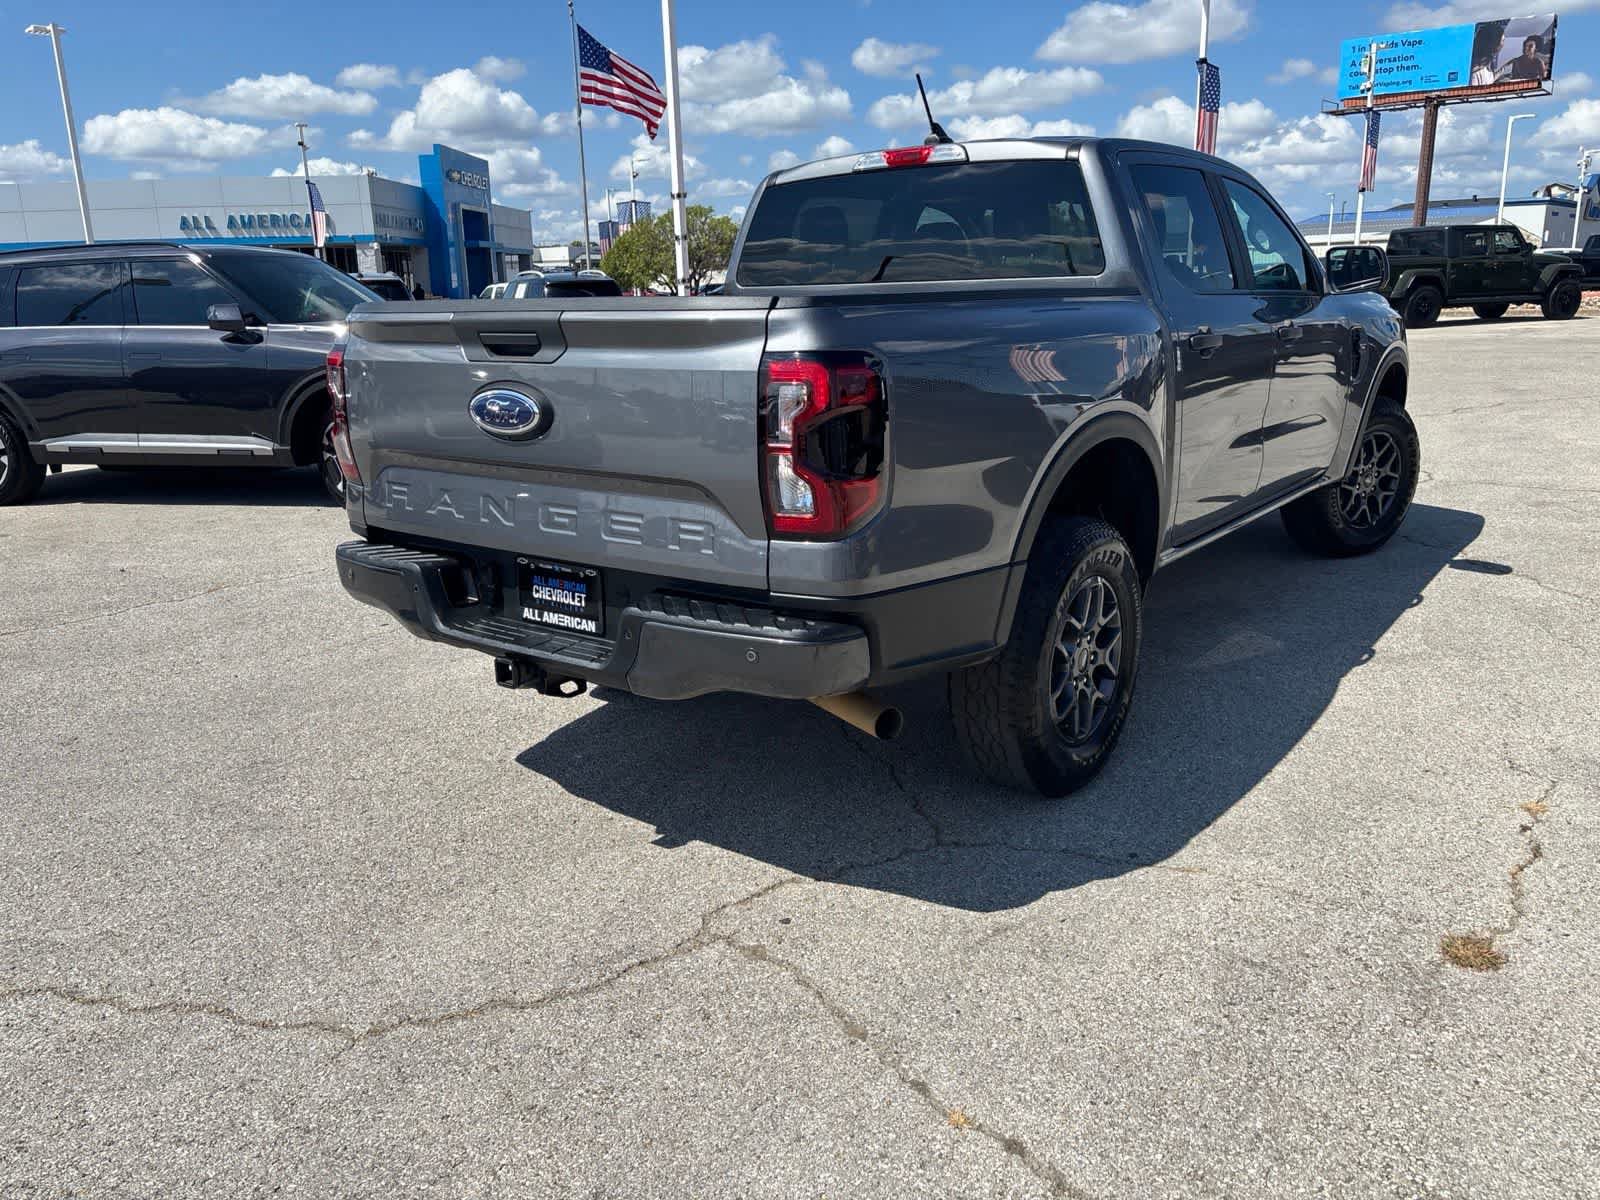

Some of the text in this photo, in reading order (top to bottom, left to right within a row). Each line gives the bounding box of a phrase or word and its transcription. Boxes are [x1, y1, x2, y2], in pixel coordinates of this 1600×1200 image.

[1358, 44, 1366, 52] in
[1401, 38, 1424, 48] Vape.
[1396, 63, 1422, 73] them.
[180, 212, 328, 231] ALL AMERICA
[384, 480, 716, 555] RANGER
[532, 585, 587, 607] CHEVROLET
[523, 607, 596, 633] ALL AMERICAN
